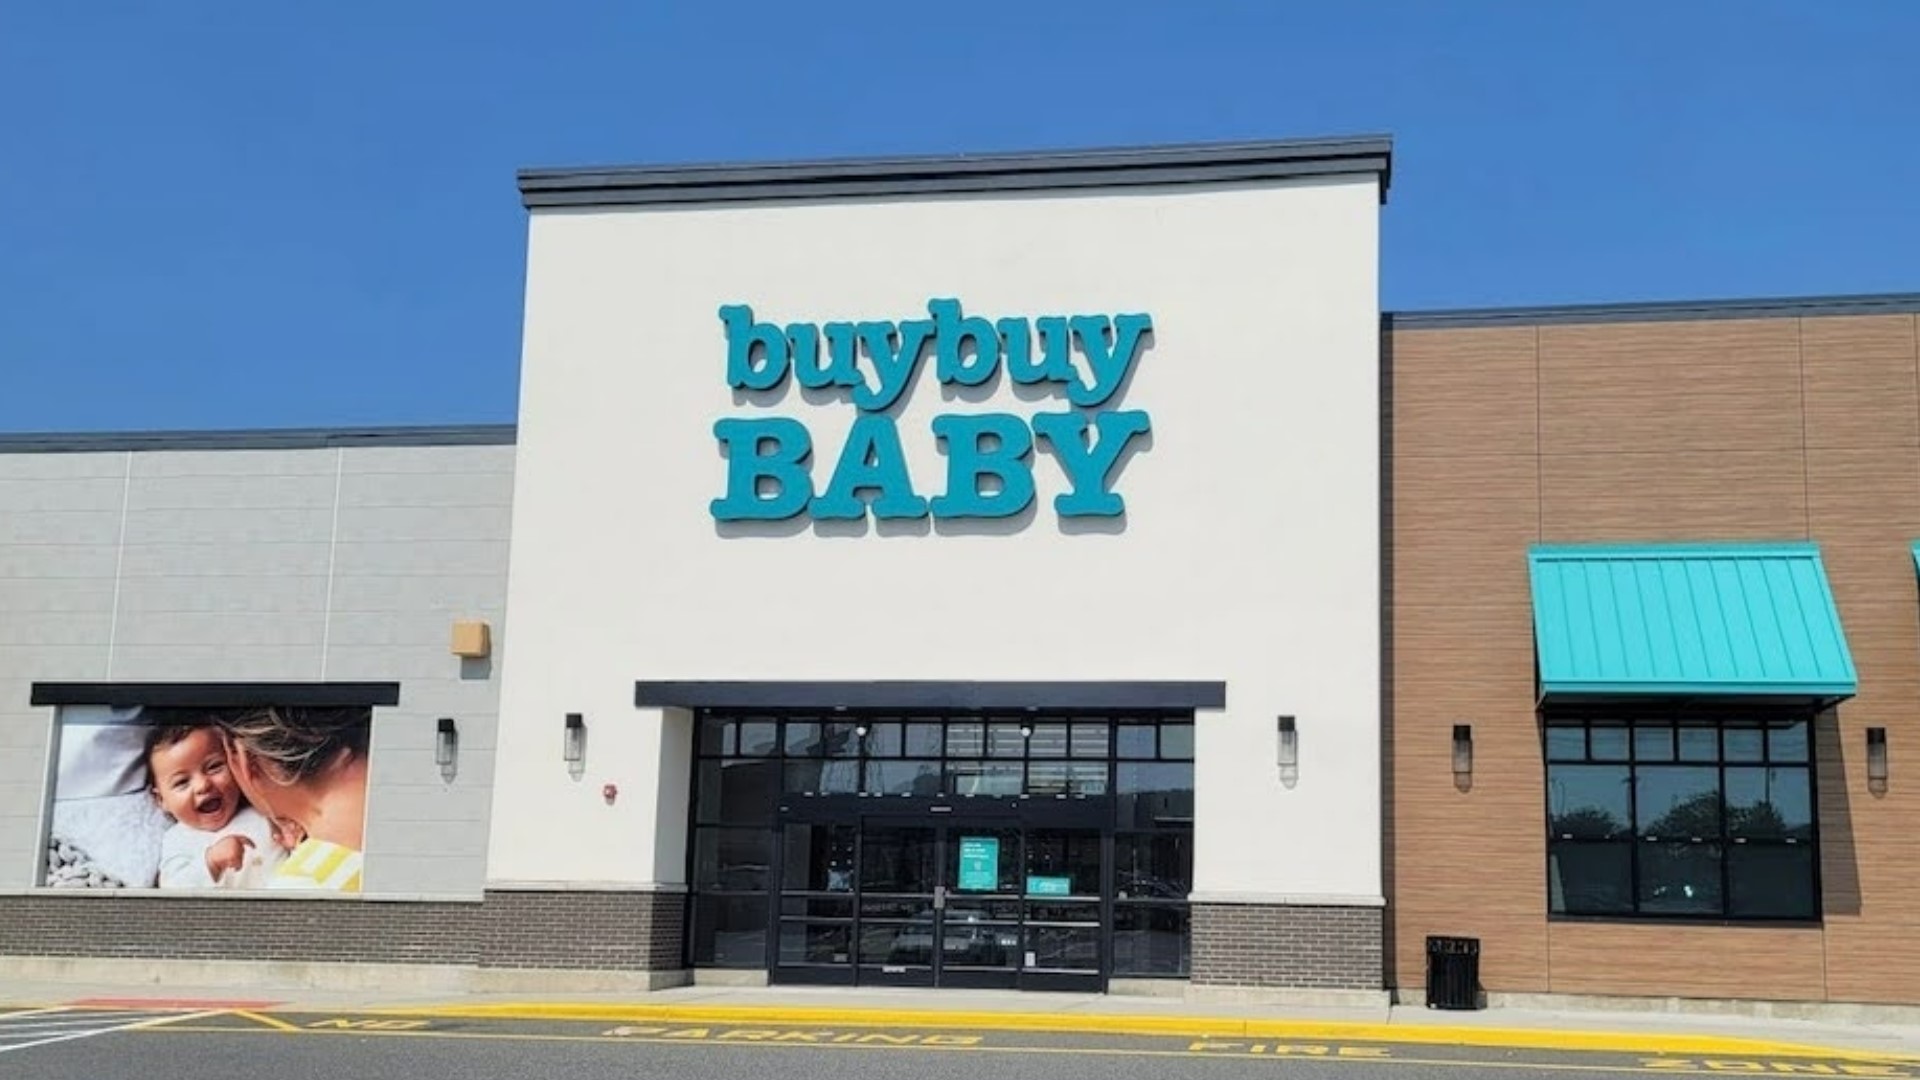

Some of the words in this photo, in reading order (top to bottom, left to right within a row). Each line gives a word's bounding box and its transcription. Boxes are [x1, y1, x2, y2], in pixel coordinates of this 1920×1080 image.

[718, 298, 1152, 410] buybuy
[710, 410, 1151, 519] BABY
[305, 1019, 431, 1030] NO
[601, 1026, 983, 1045] PARKING
[1189, 1042, 1391, 1057] FIRE
[1638, 1057, 1910, 1077] ZONE
